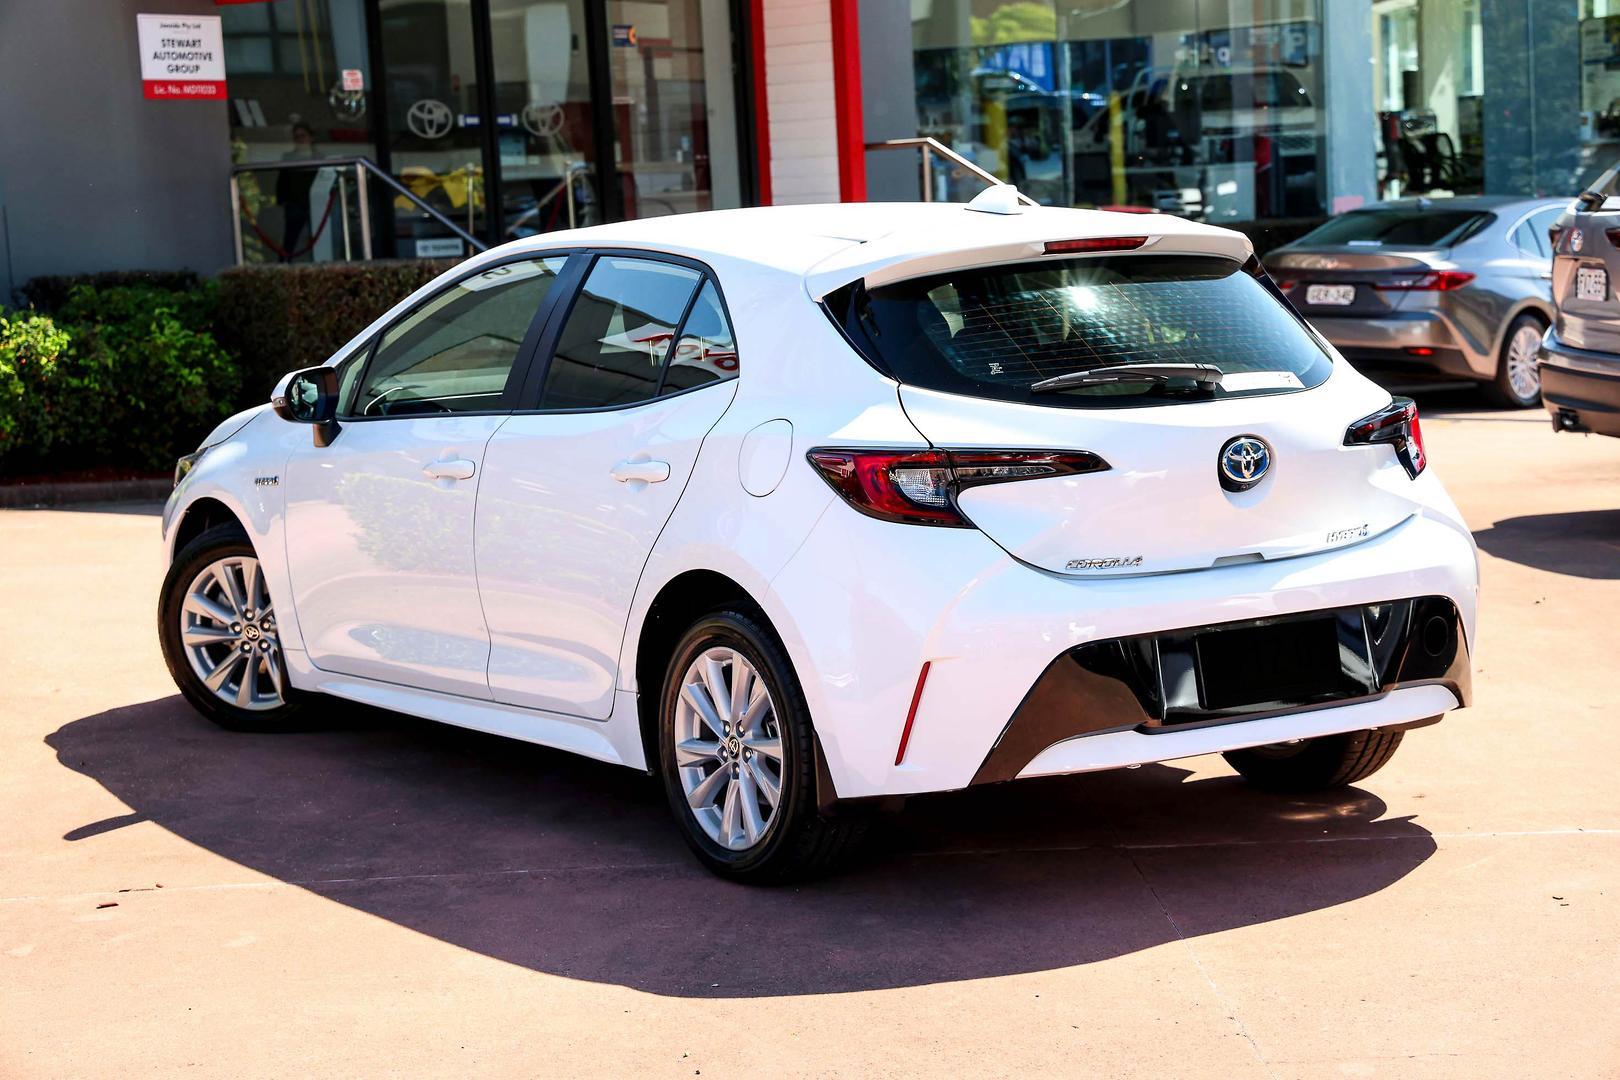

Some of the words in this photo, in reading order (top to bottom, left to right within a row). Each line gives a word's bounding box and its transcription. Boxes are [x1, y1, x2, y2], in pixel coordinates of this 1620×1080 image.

[161, 39, 201, 48] STEWART
[153, 52, 213, 61] AUTOMOTIVE
[167, 64, 201, 73] GROUP
[1065, 555, 1143, 570] COROLLA
